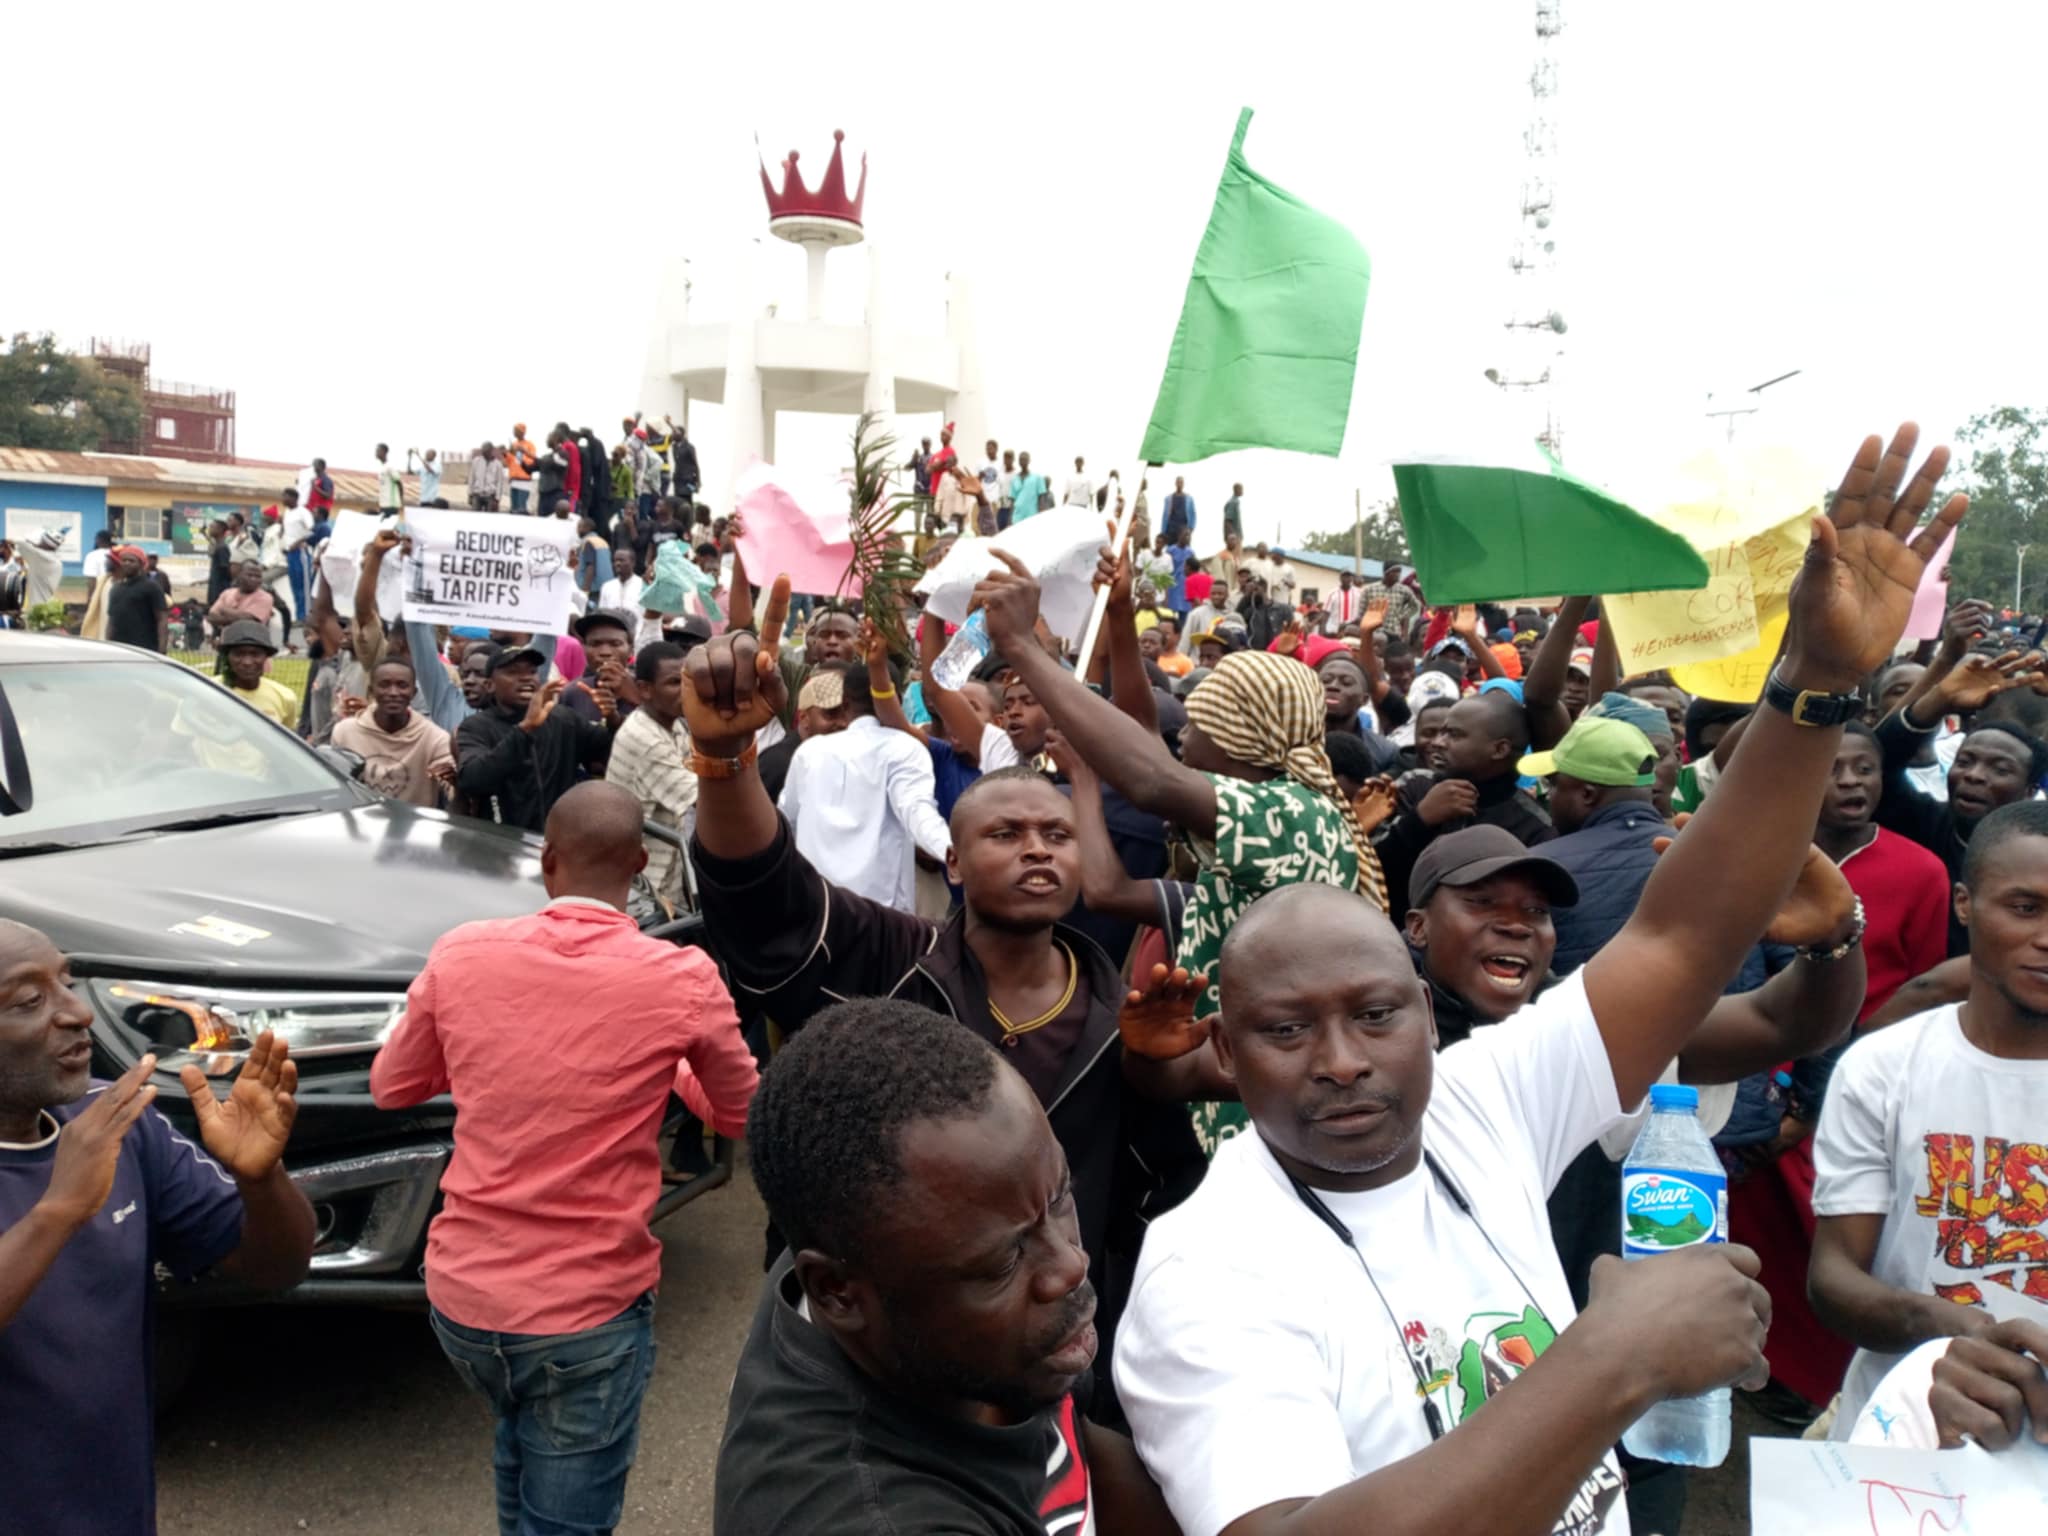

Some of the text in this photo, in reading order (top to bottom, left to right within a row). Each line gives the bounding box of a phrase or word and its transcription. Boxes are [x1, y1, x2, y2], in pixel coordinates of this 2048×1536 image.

[455, 530, 525, 557] REDUCE
[439, 553, 524, 582] ELECTRIC
[441, 577, 520, 607] TARIFFS
[1631, 1183, 1690, 1209] Swan
